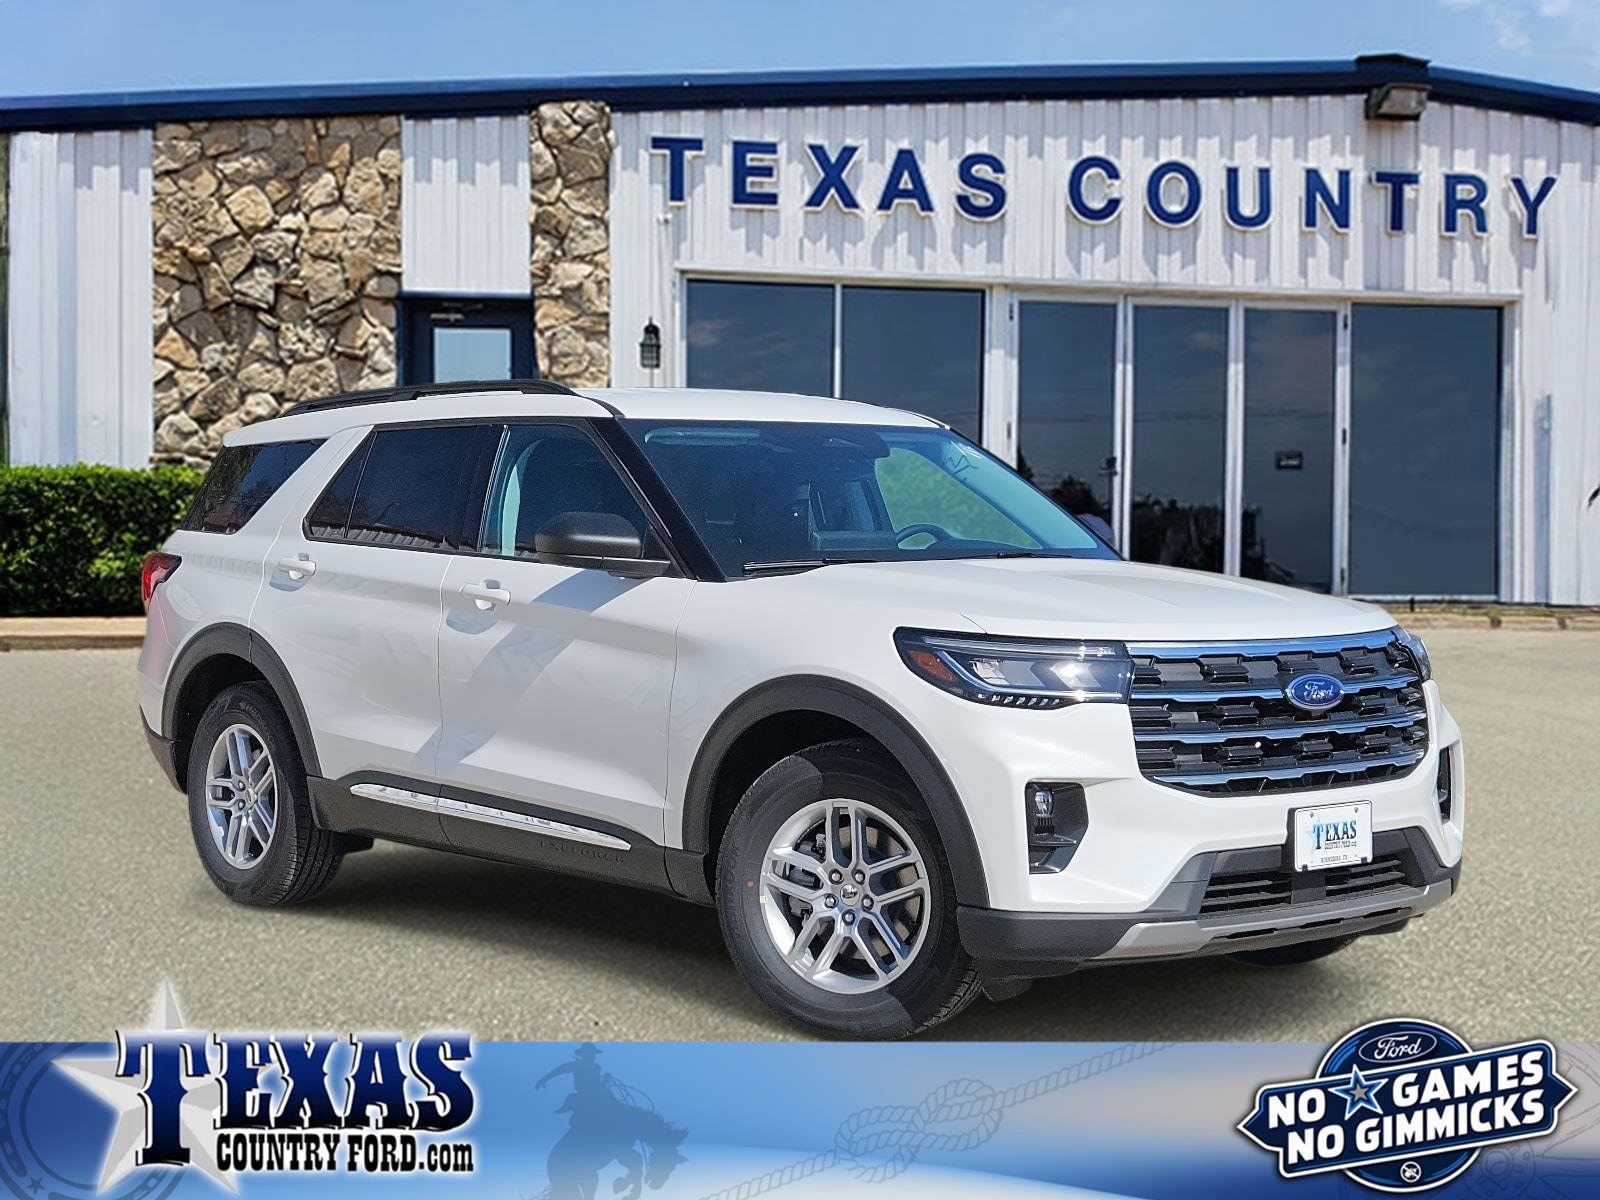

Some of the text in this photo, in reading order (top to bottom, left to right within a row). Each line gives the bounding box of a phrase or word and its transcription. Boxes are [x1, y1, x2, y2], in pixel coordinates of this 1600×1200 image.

[650, 136, 1557, 238] TEXAS COUNTRY
[1304, 681, 1334, 700] Ford
[1313, 820, 1357, 849] TEXAS
